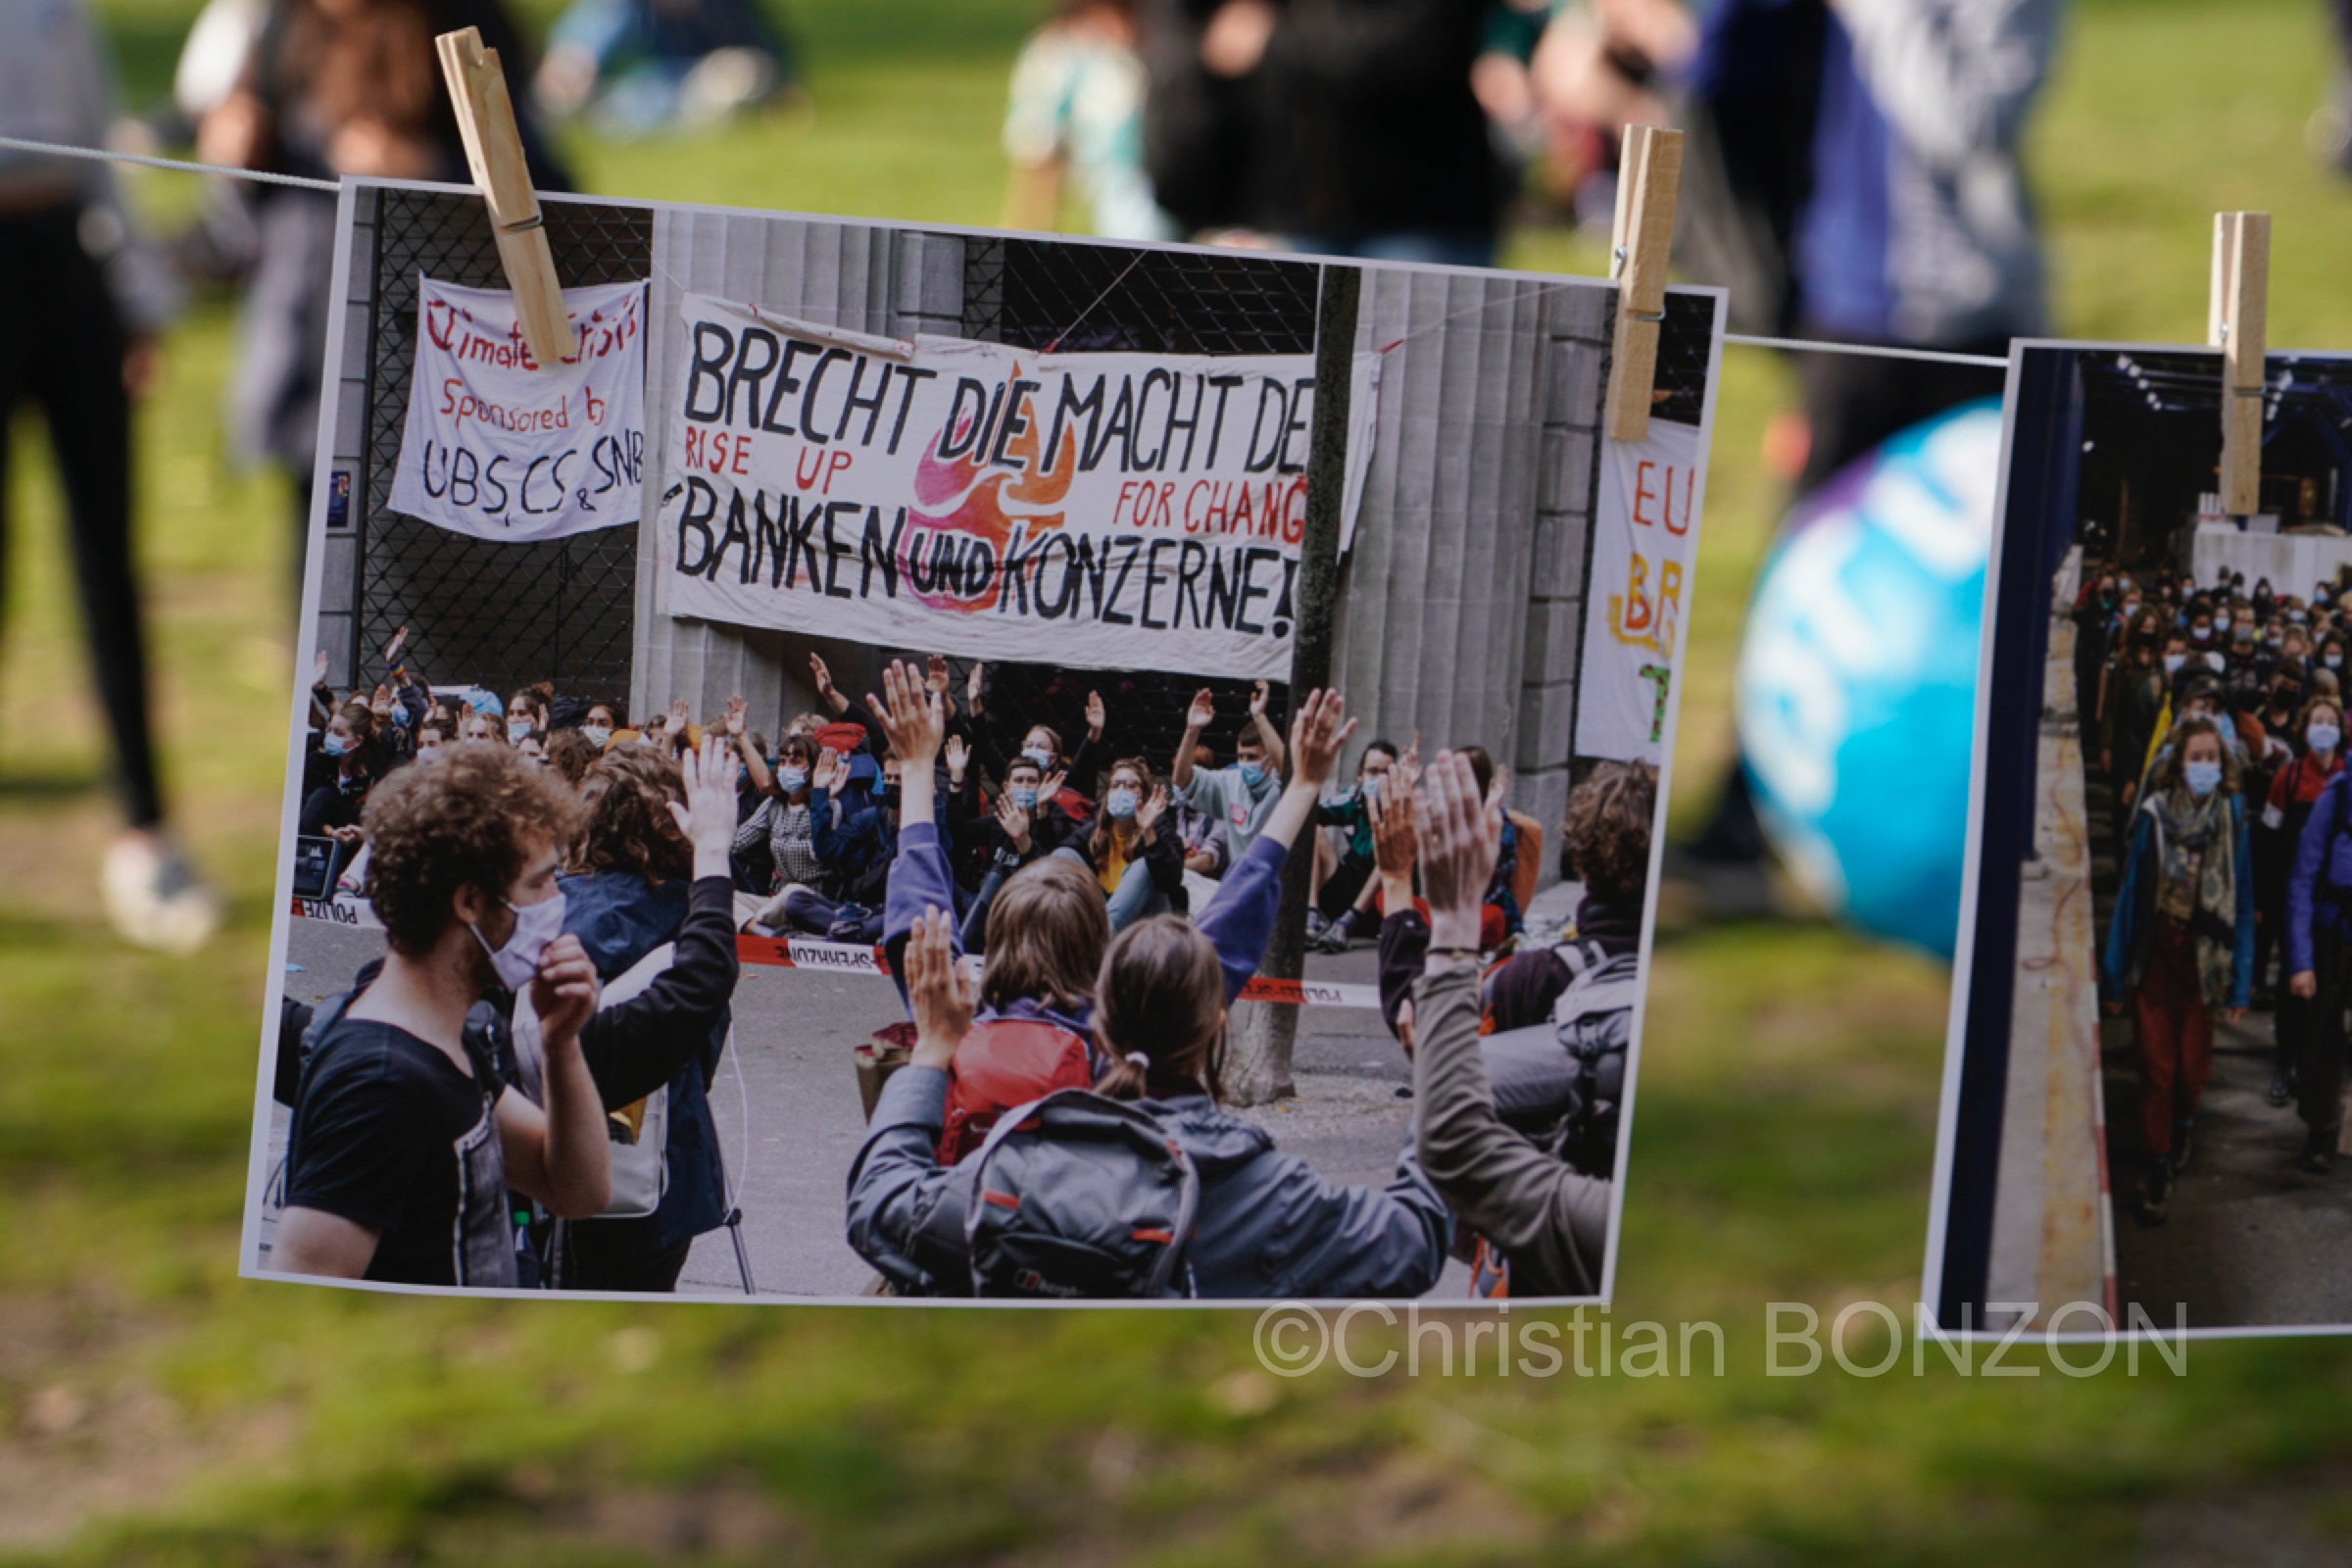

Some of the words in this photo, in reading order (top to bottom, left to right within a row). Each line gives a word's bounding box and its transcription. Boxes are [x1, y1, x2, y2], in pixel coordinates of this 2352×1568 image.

[440, 378, 569, 431] Sponsored
[684, 320, 937, 456] BRECHT
[937, 375, 1042, 469] DIE
[1041, 367, 1244, 473] MACHT
[592, 428, 644, 495] SNB
[685, 425, 753, 476] RISE
[795, 447, 853, 495] UP
[1113, 480, 1176, 528] FOR
[1183, 475, 1307, 545] CHANG
[1633, 461, 1694, 536] EU
[676, 475, 907, 599] BANKEN
[907, 531, 996, 598] UND
[998, 524, 1302, 638] KONZERNE!
